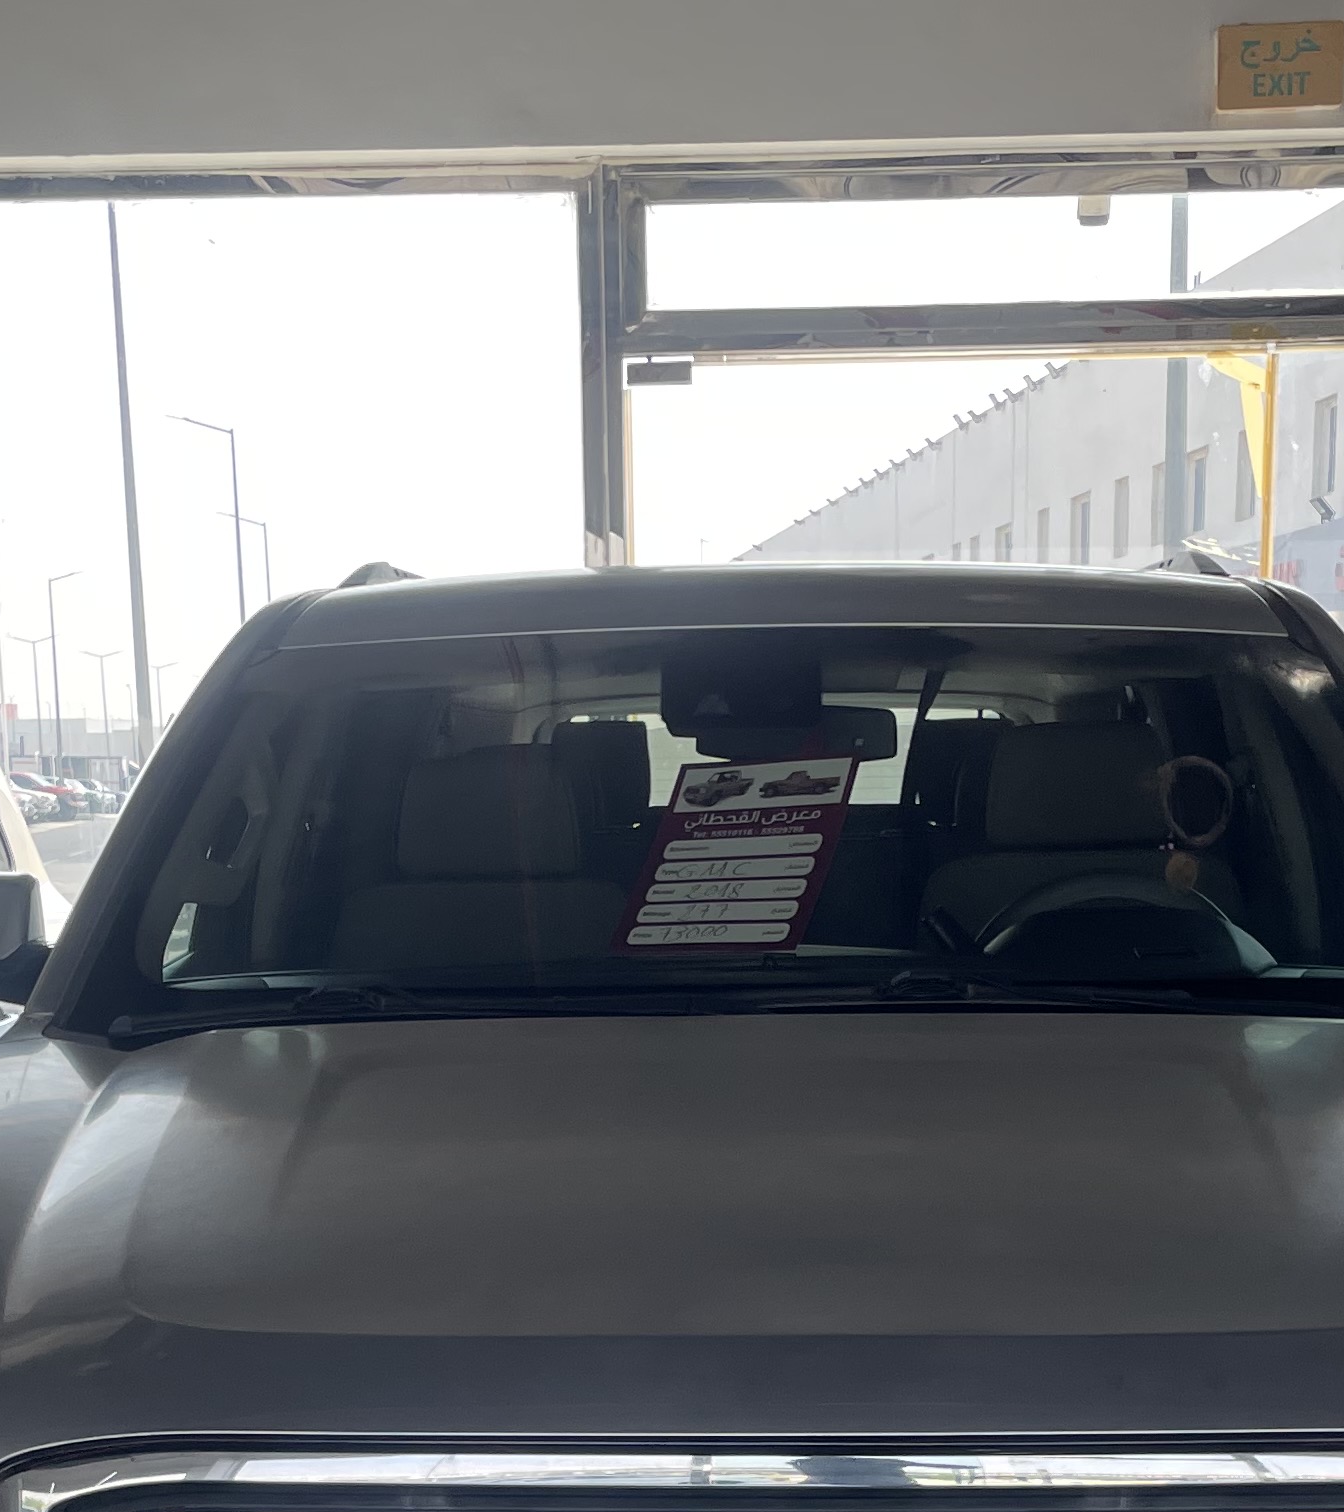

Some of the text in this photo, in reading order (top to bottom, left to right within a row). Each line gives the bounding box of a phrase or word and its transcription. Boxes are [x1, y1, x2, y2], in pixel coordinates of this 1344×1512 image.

[1240, 29, 1322, 69] خروج
[1252, 71, 1311, 97] EXIT
[684, 809, 822, 832] معرض القحطاني
